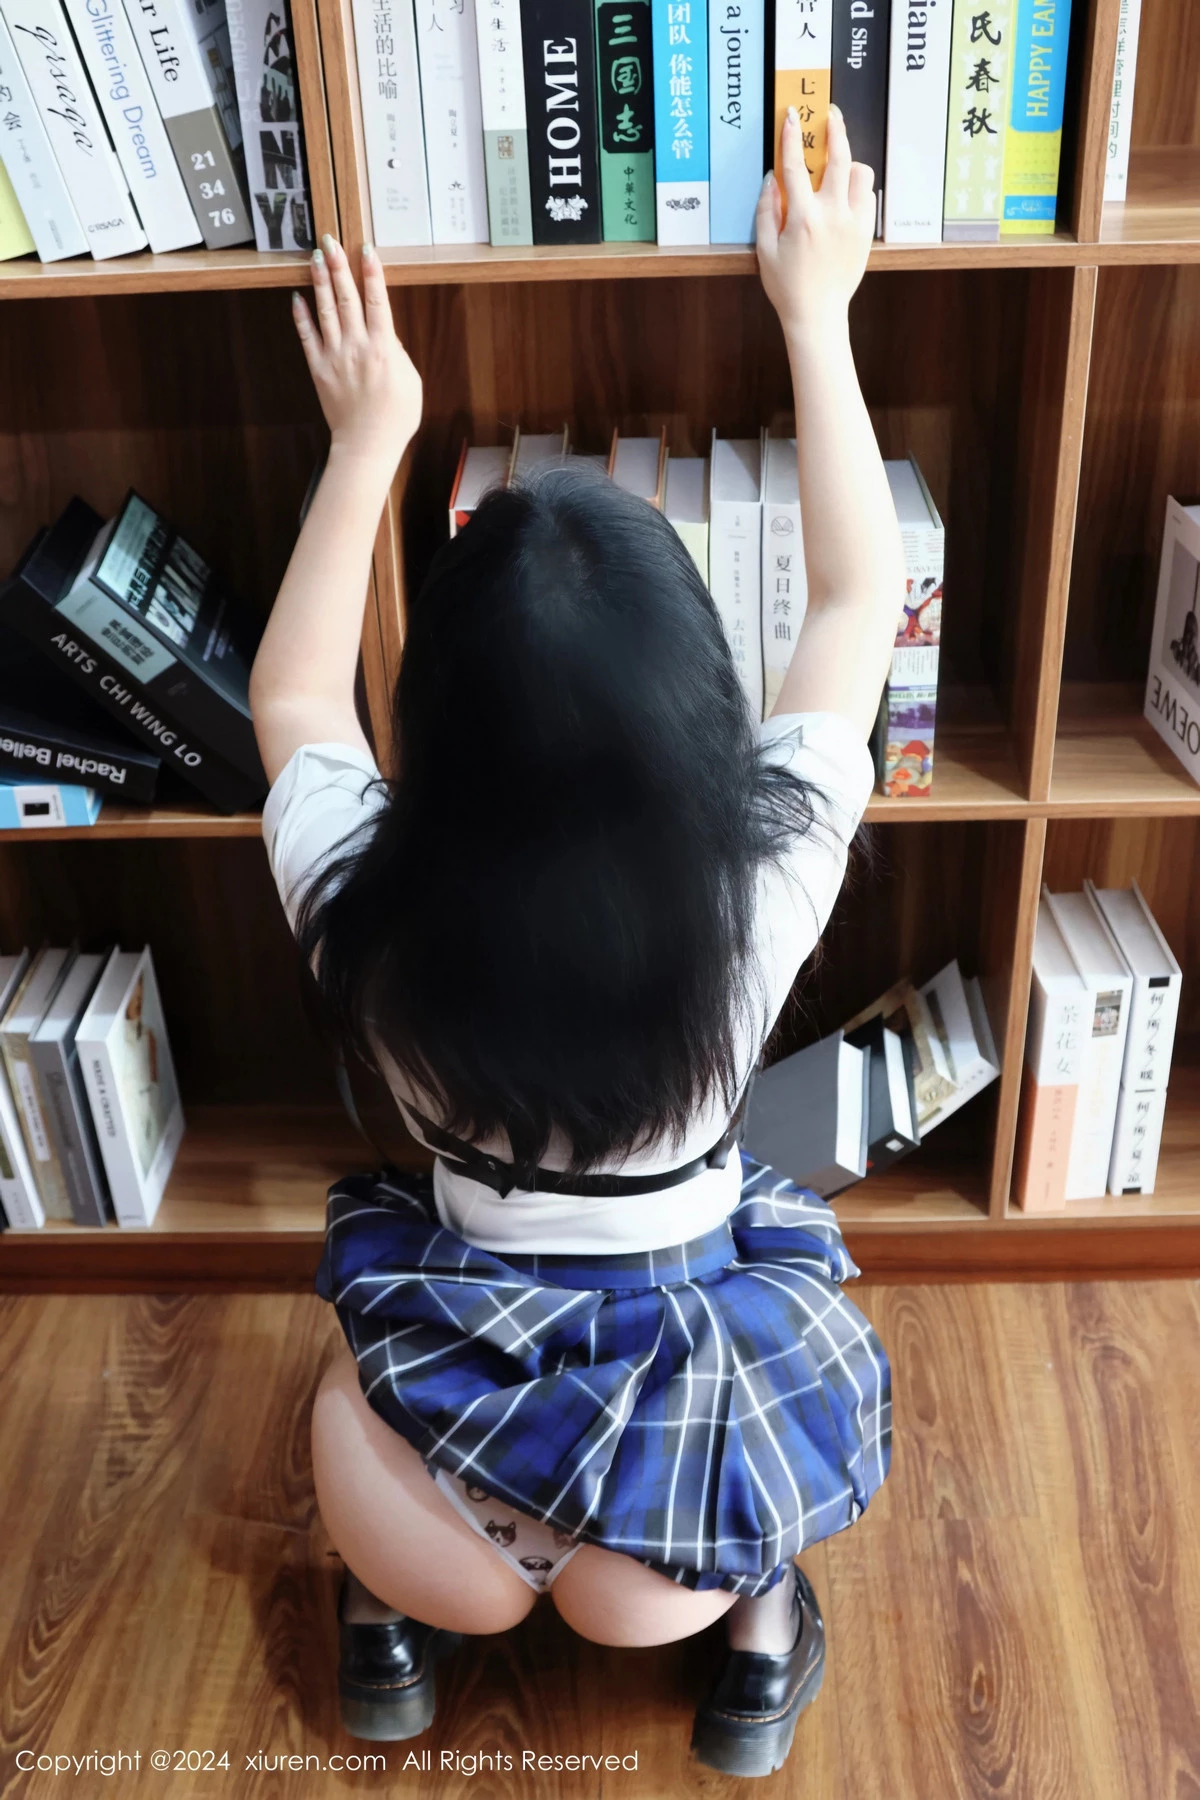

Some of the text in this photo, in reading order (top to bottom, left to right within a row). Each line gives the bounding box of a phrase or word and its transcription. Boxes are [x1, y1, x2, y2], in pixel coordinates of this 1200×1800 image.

[85, 0, 157, 179] Glittering Dream
[150, 25, 180, 83] Life
[667, 2, 693, 160] 团队 你能怎么管
[720, 5, 749, 130] a journey
[961, 10, 1002, 138] 氏春秋
[1026, 43, 1053, 117] HAPPY
[543, 37, 583, 188] HOME
[190, 150, 216, 171] 21
[199, 179, 226, 200] 34
[208, 207, 236, 228] 76
[773, 554, 793, 642] 夏日终曲
[51, 632, 97, 674] ARTS
[99, 675, 133, 705] CHI
[129, 701, 178, 747] WING
[173, 743, 202, 768] LO
[56, 750, 128, 785] Rachel
